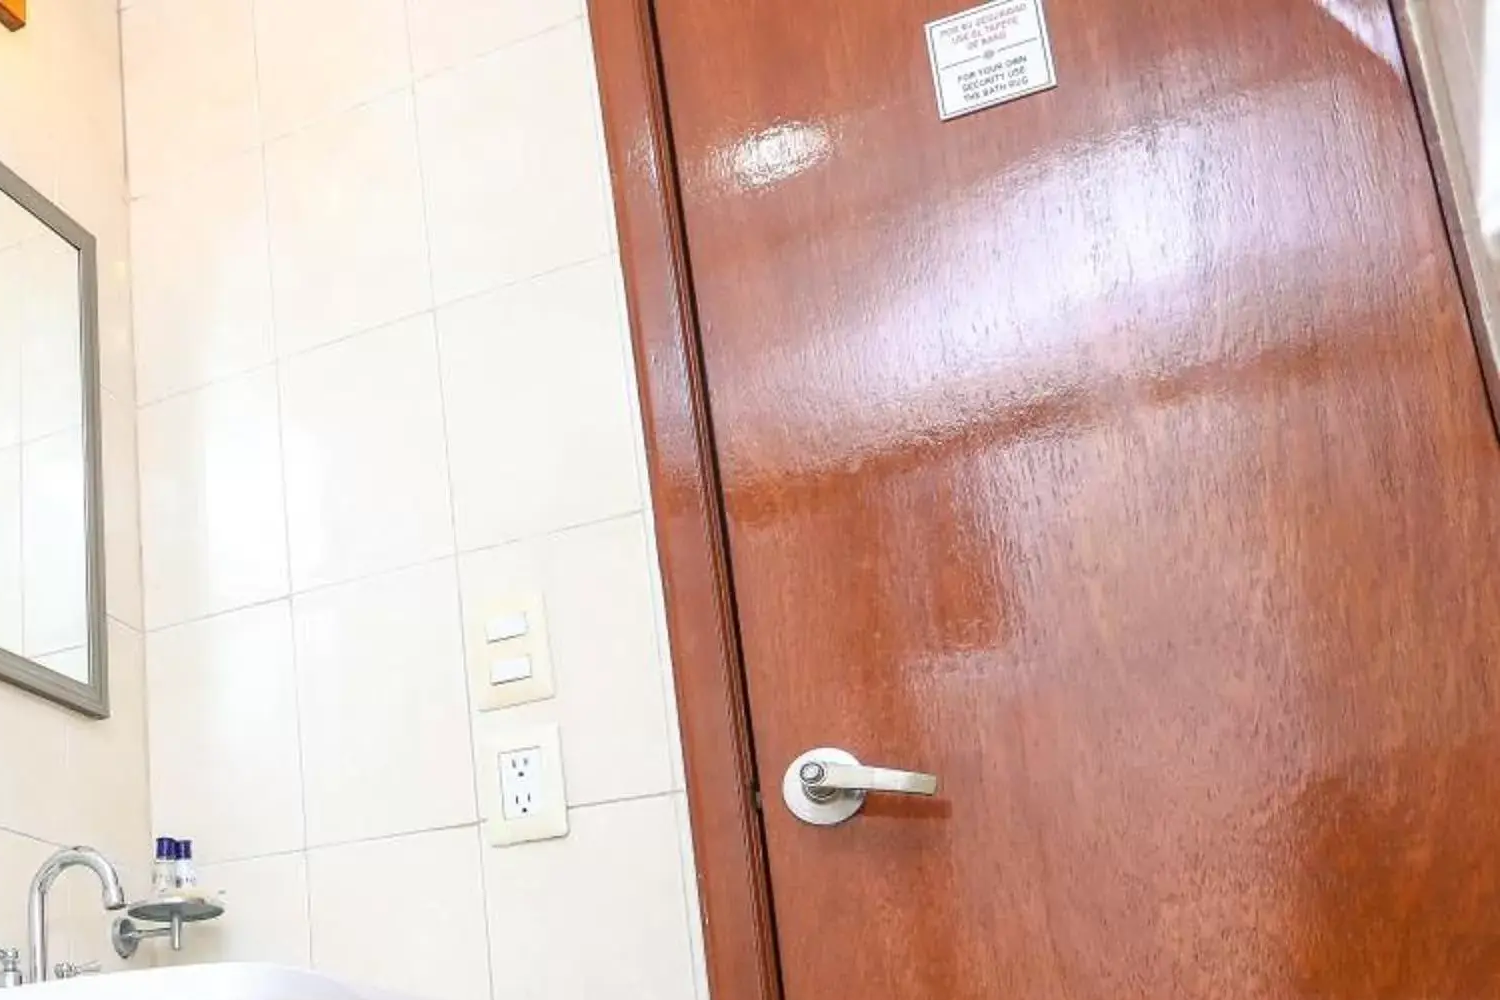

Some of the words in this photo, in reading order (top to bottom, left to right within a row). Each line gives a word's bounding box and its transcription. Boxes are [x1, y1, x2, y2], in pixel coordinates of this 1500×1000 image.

[957, 71, 977, 82] FOR
[979, 63, 1003, 75] YOUR
[1005, 55, 1028, 67] OWN
[961, 73, 1006, 92] SECURITY
[1008, 66, 1025, 78] USE
[963, 91, 981, 102] THE
[983, 83, 1007, 96] BATH
[1008, 77, 1029, 87] RUG
